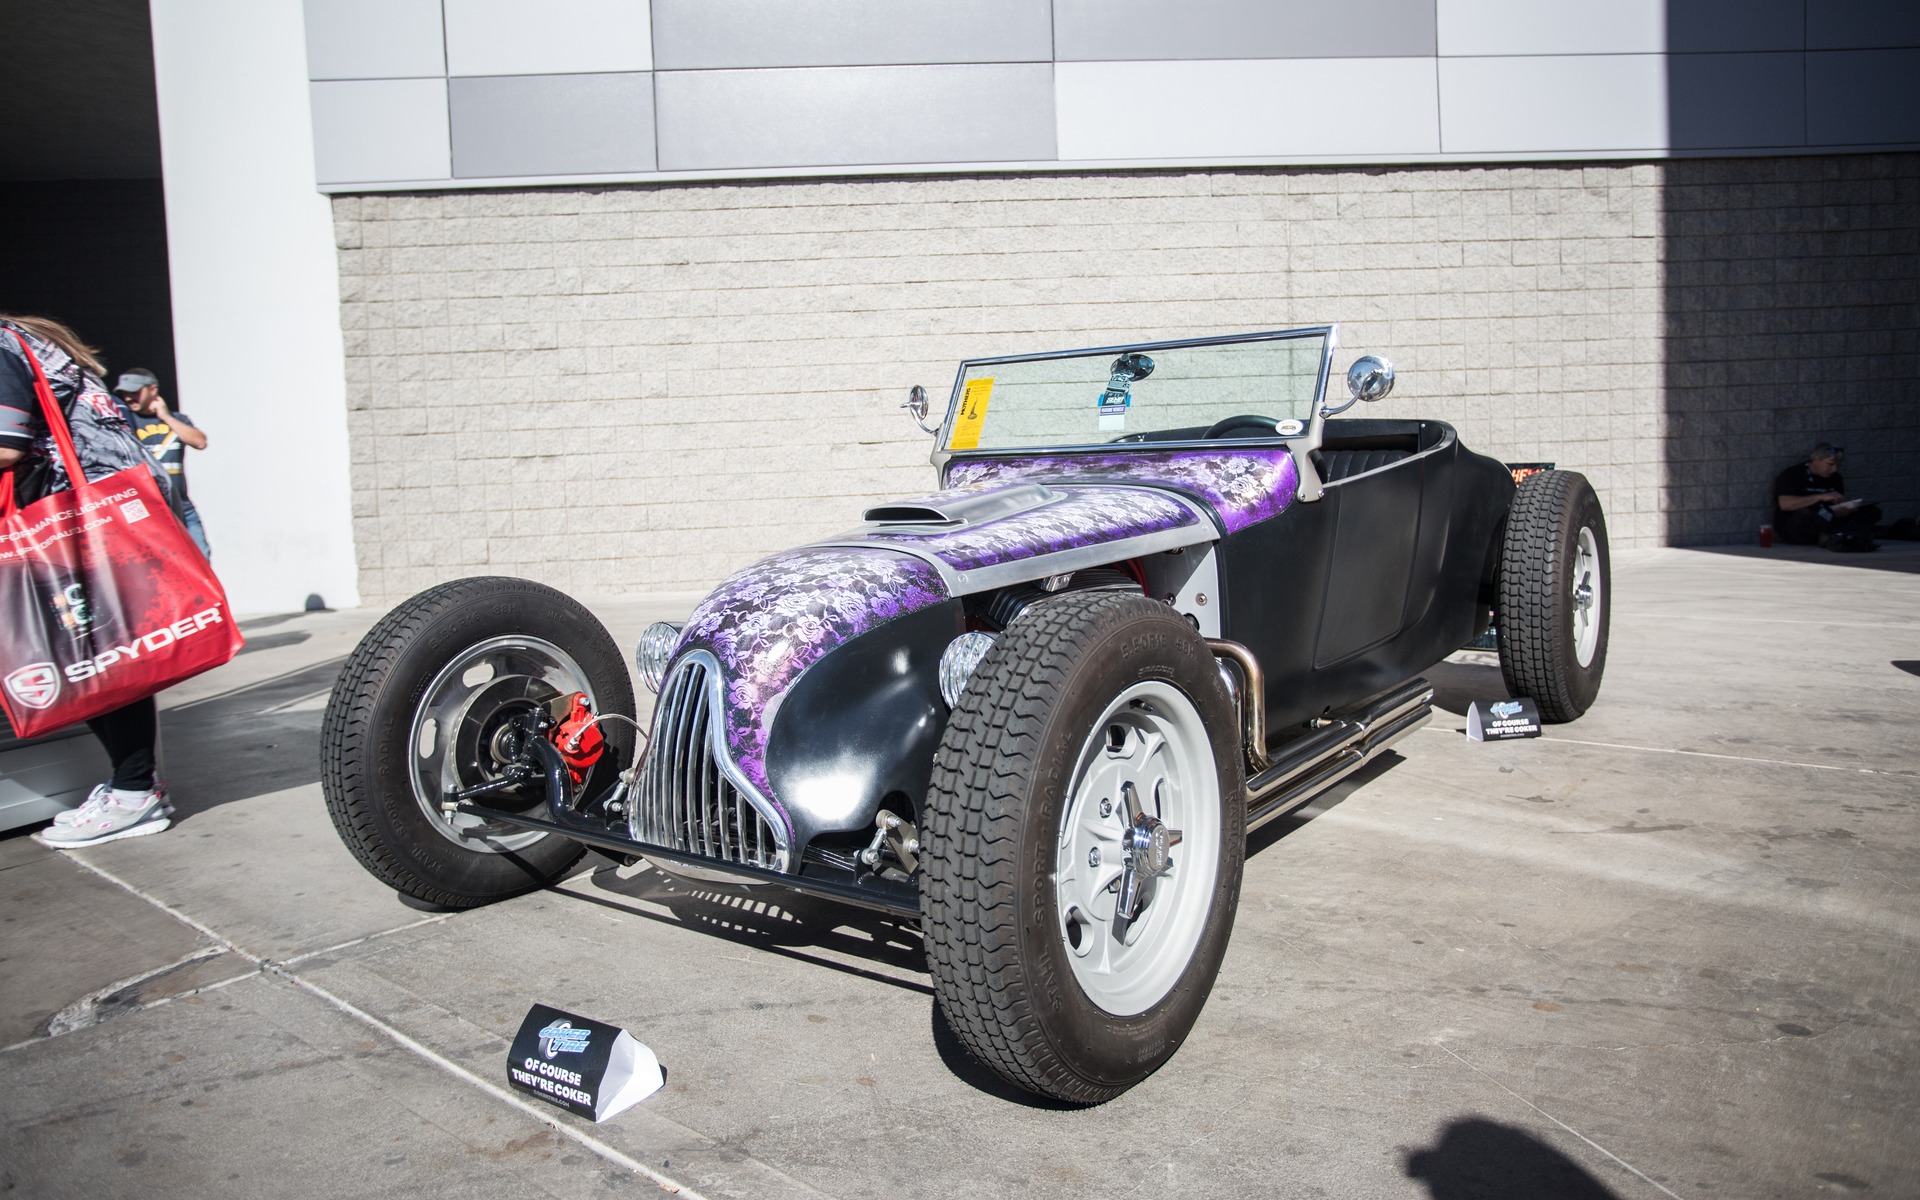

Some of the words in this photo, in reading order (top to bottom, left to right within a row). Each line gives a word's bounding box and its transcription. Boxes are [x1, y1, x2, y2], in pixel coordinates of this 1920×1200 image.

[0, 508, 74, 543] FORMANCE
[75, 487, 139, 516] LIGHTING
[64, 606, 223, 683] SPYDER
[1486, 727, 1514, 735] THEY'RE
[1514, 725, 1538, 733] COKER
[1502, 718, 1529, 727] COURSE
[378, 718, 395, 777] RADIAL
[1039, 732, 1072, 818] RADIAL
[1033, 842, 1046, 924] SPORT
[538, 1026, 592, 1041] COKER
[551, 1039, 591, 1053] TIRE
[512, 1068, 555, 1093] THEY'RE
[554, 1083, 592, 1107] COKER
[524, 1057, 543, 1074] OF
[541, 1061, 582, 1087] COURSE
